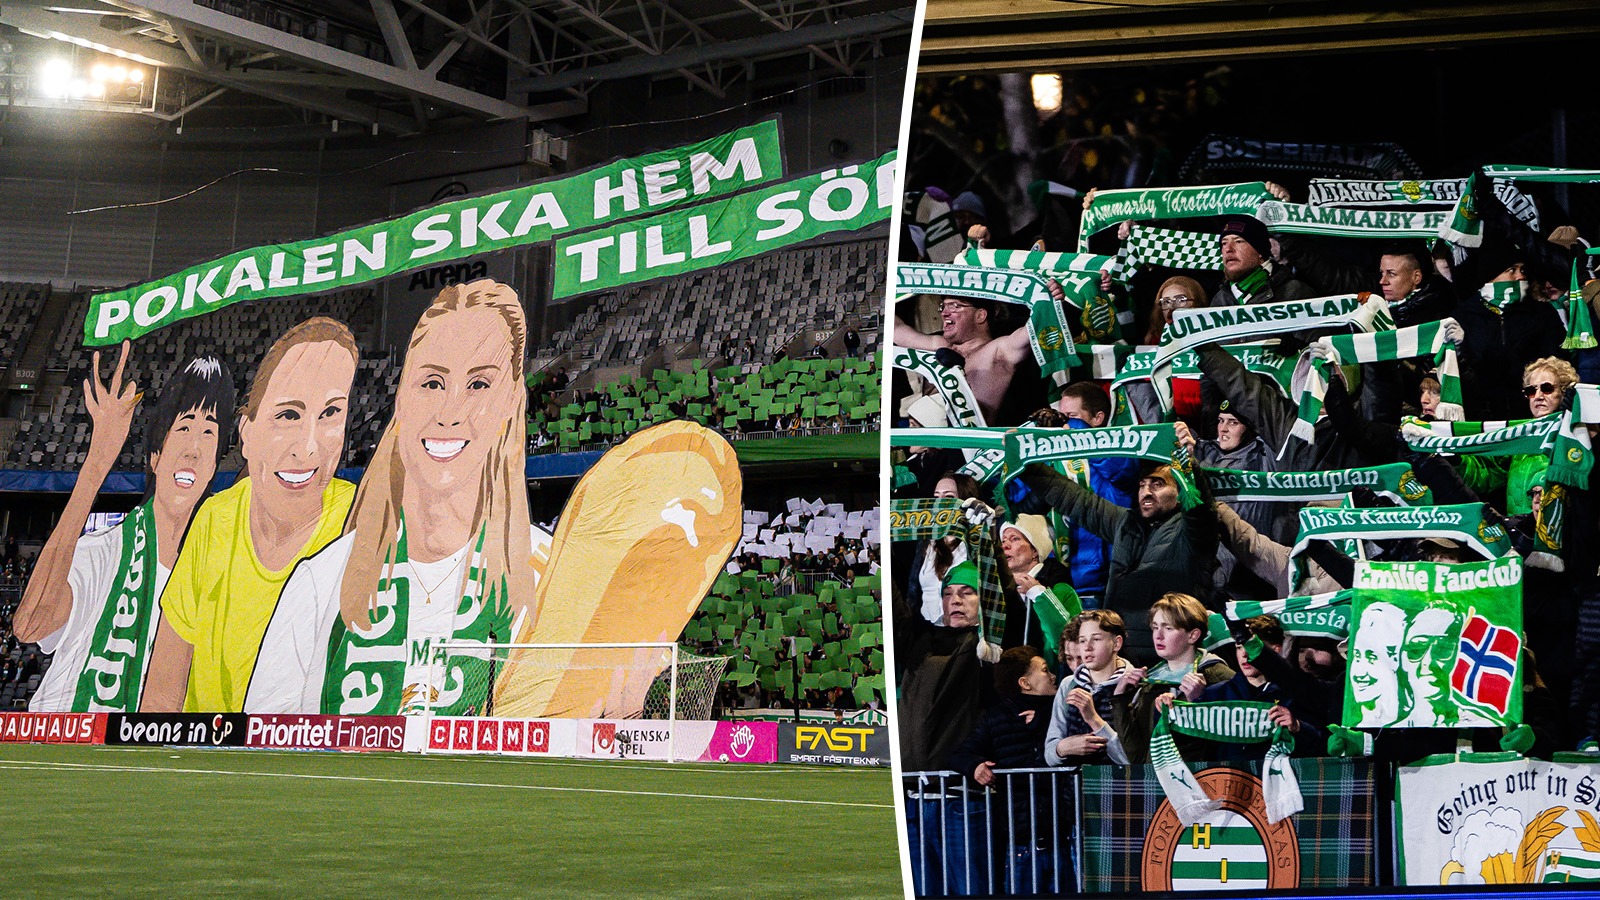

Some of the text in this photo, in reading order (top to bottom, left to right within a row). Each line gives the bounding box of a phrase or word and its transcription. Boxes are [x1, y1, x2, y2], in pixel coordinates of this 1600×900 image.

[1285, 203, 1416, 229] HAMMARBY
[1423, 213, 1446, 229] IF
[94, 137, 763, 338] POKALEN SKA HEM
[565, 215, 732, 283] TILL
[408, 261, 487, 291] Arena
[1158, 297, 1359, 348] GULLMARSPLAN
[15, 369, 36, 379] B302
[1016, 427, 1158, 460] Hammarby
[1241, 470, 1260, 489] is
[1266, 469, 1379, 493] Kanalplan
[1299, 510, 1338, 534] This
[1359, 507, 1462, 529] Kanalplan
[1353, 558, 1522, 593] Emilie Fanclub
[0, 716, 93, 738] AUHAUS
[120, 716, 182, 742] beans
[188, 722, 207, 742] in
[247, 717, 403, 748] Prioritet Finans
[434, 726, 545, 747] CRAMO
[796, 726, 874, 752] FAST
[790, 754, 821, 763] SMART
[1437, 779, 1498, 835] Going
[1505, 768, 1538, 794] out
[1547, 768, 1568, 798] in
